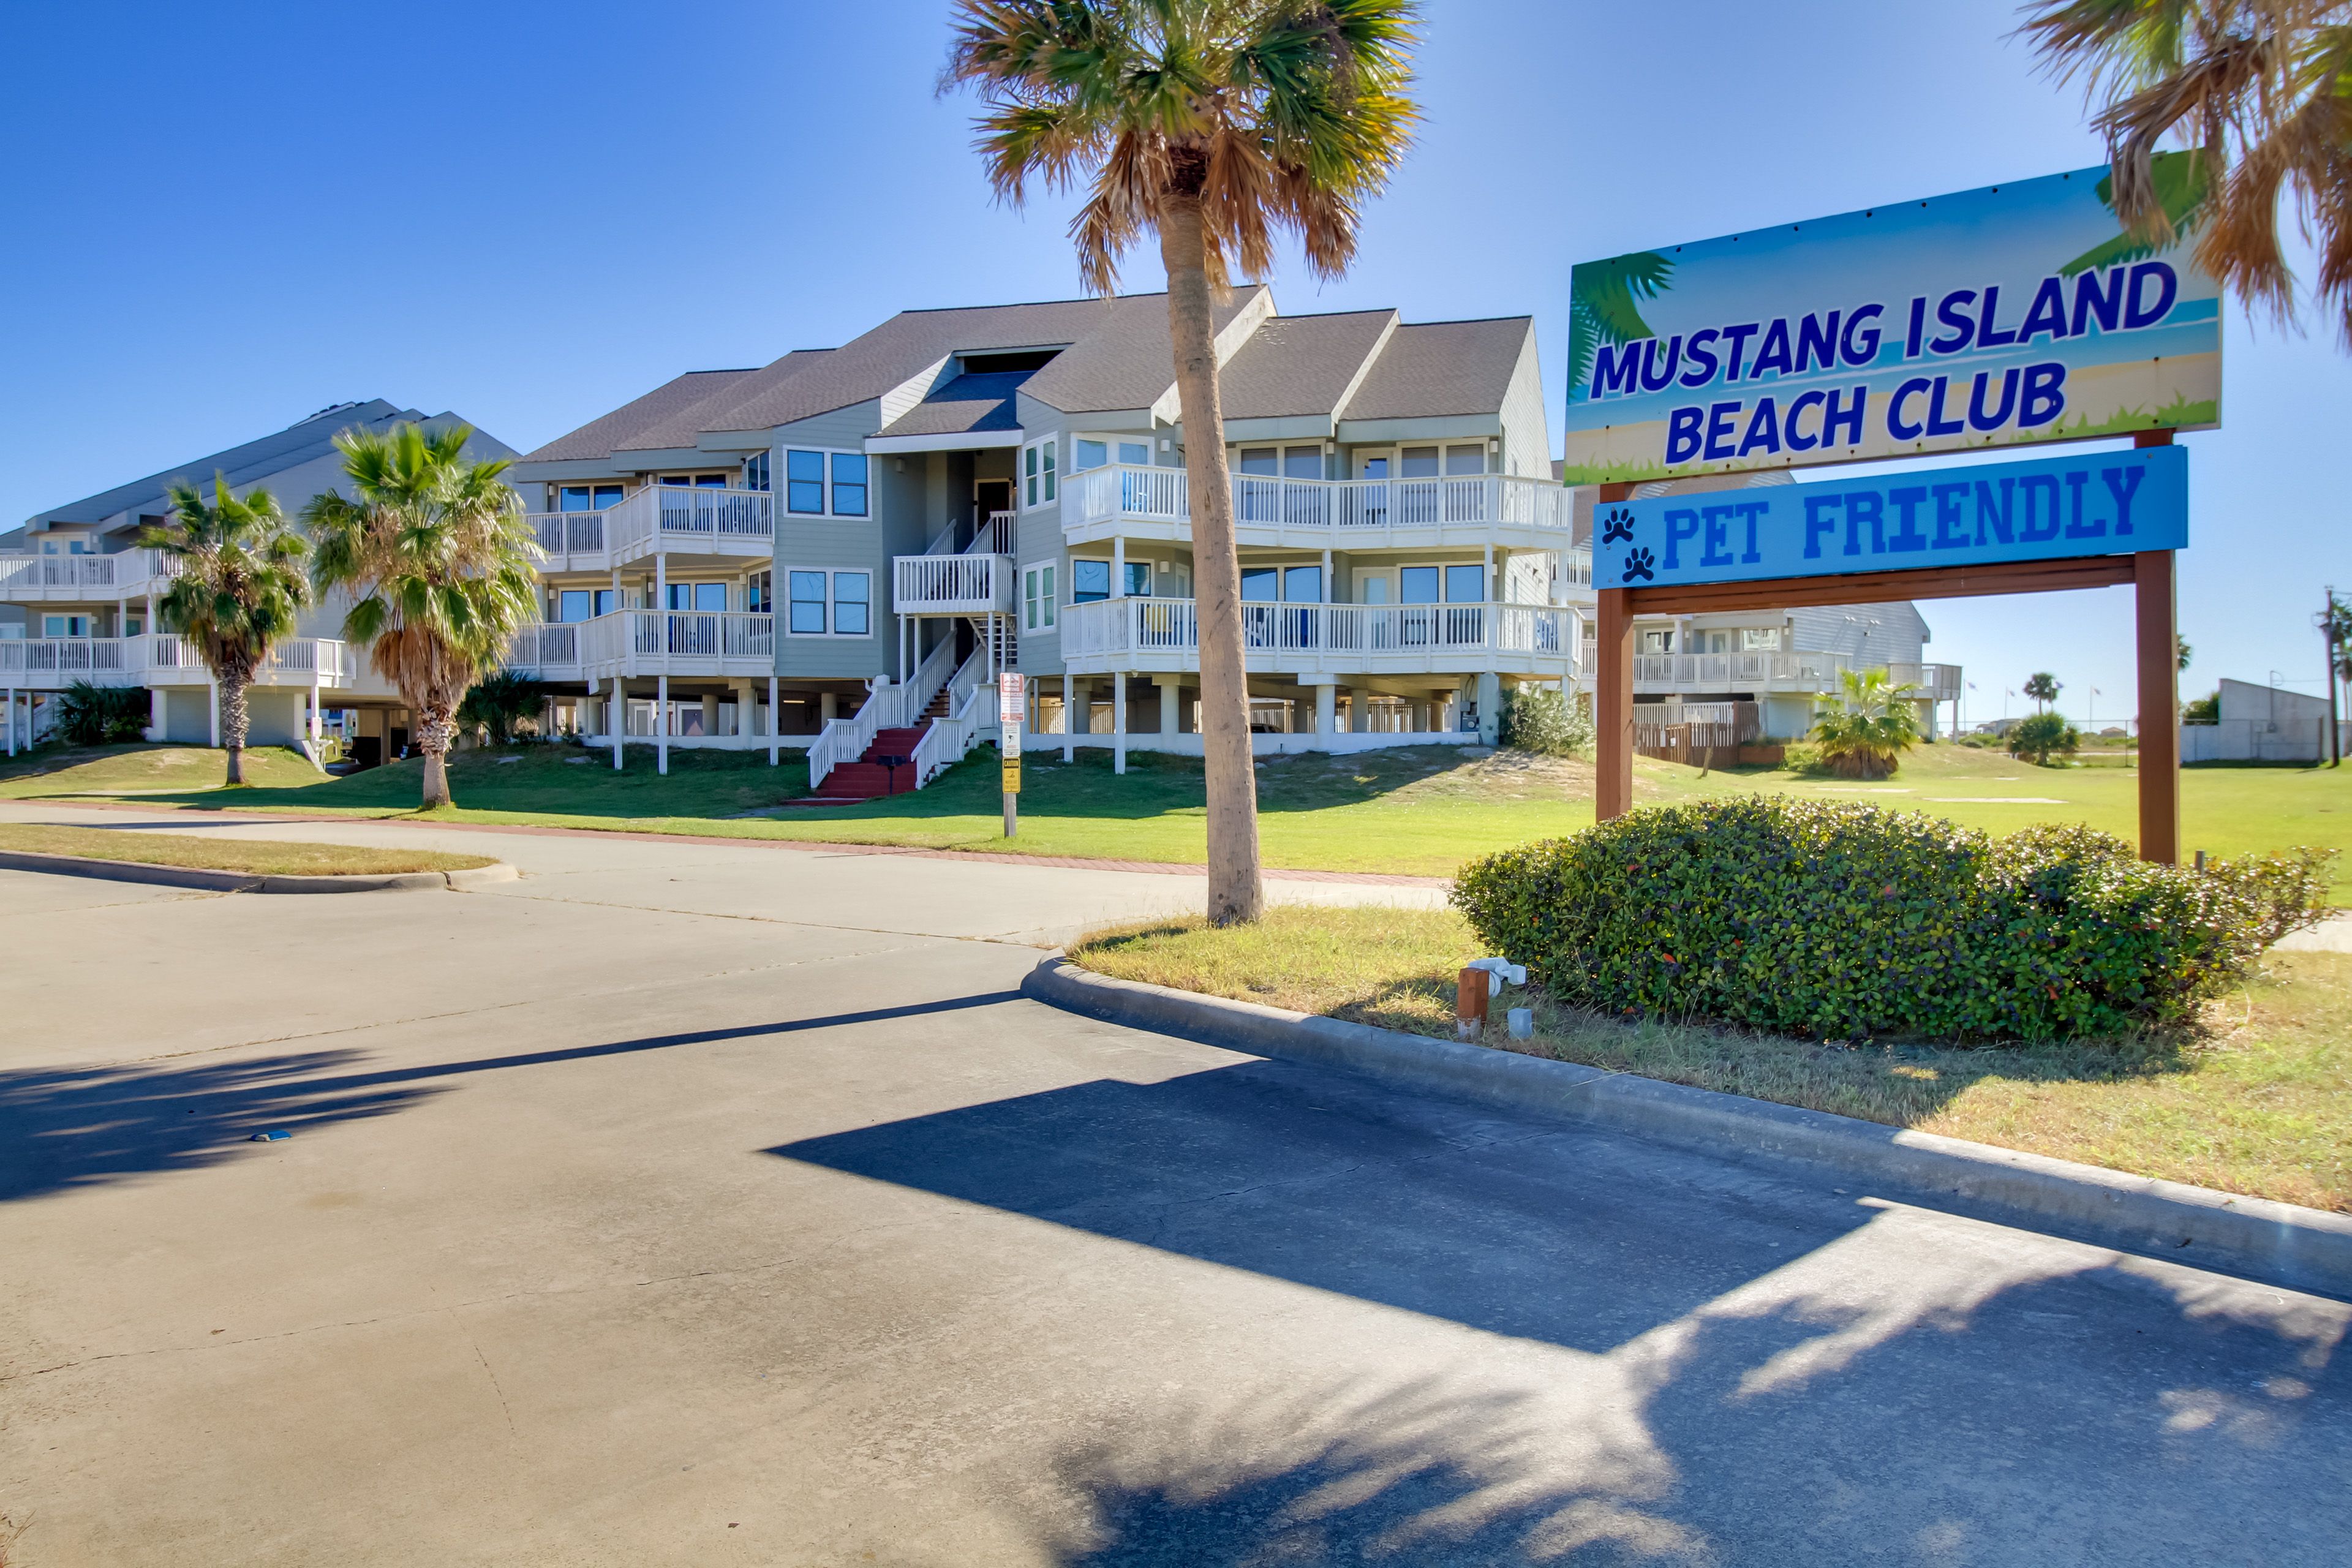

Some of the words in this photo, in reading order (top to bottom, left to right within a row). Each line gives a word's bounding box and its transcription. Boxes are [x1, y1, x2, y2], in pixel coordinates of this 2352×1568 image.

[1591, 303, 1885, 399] MUSTANG
[1905, 262, 2177, 357] ISLAND
[1665, 385, 1868, 464] BEACH
[1887, 362, 2066, 440] CLUB
[1662, 500, 1770, 570] PET
[1803, 465, 2146, 560] FRIENDLY
